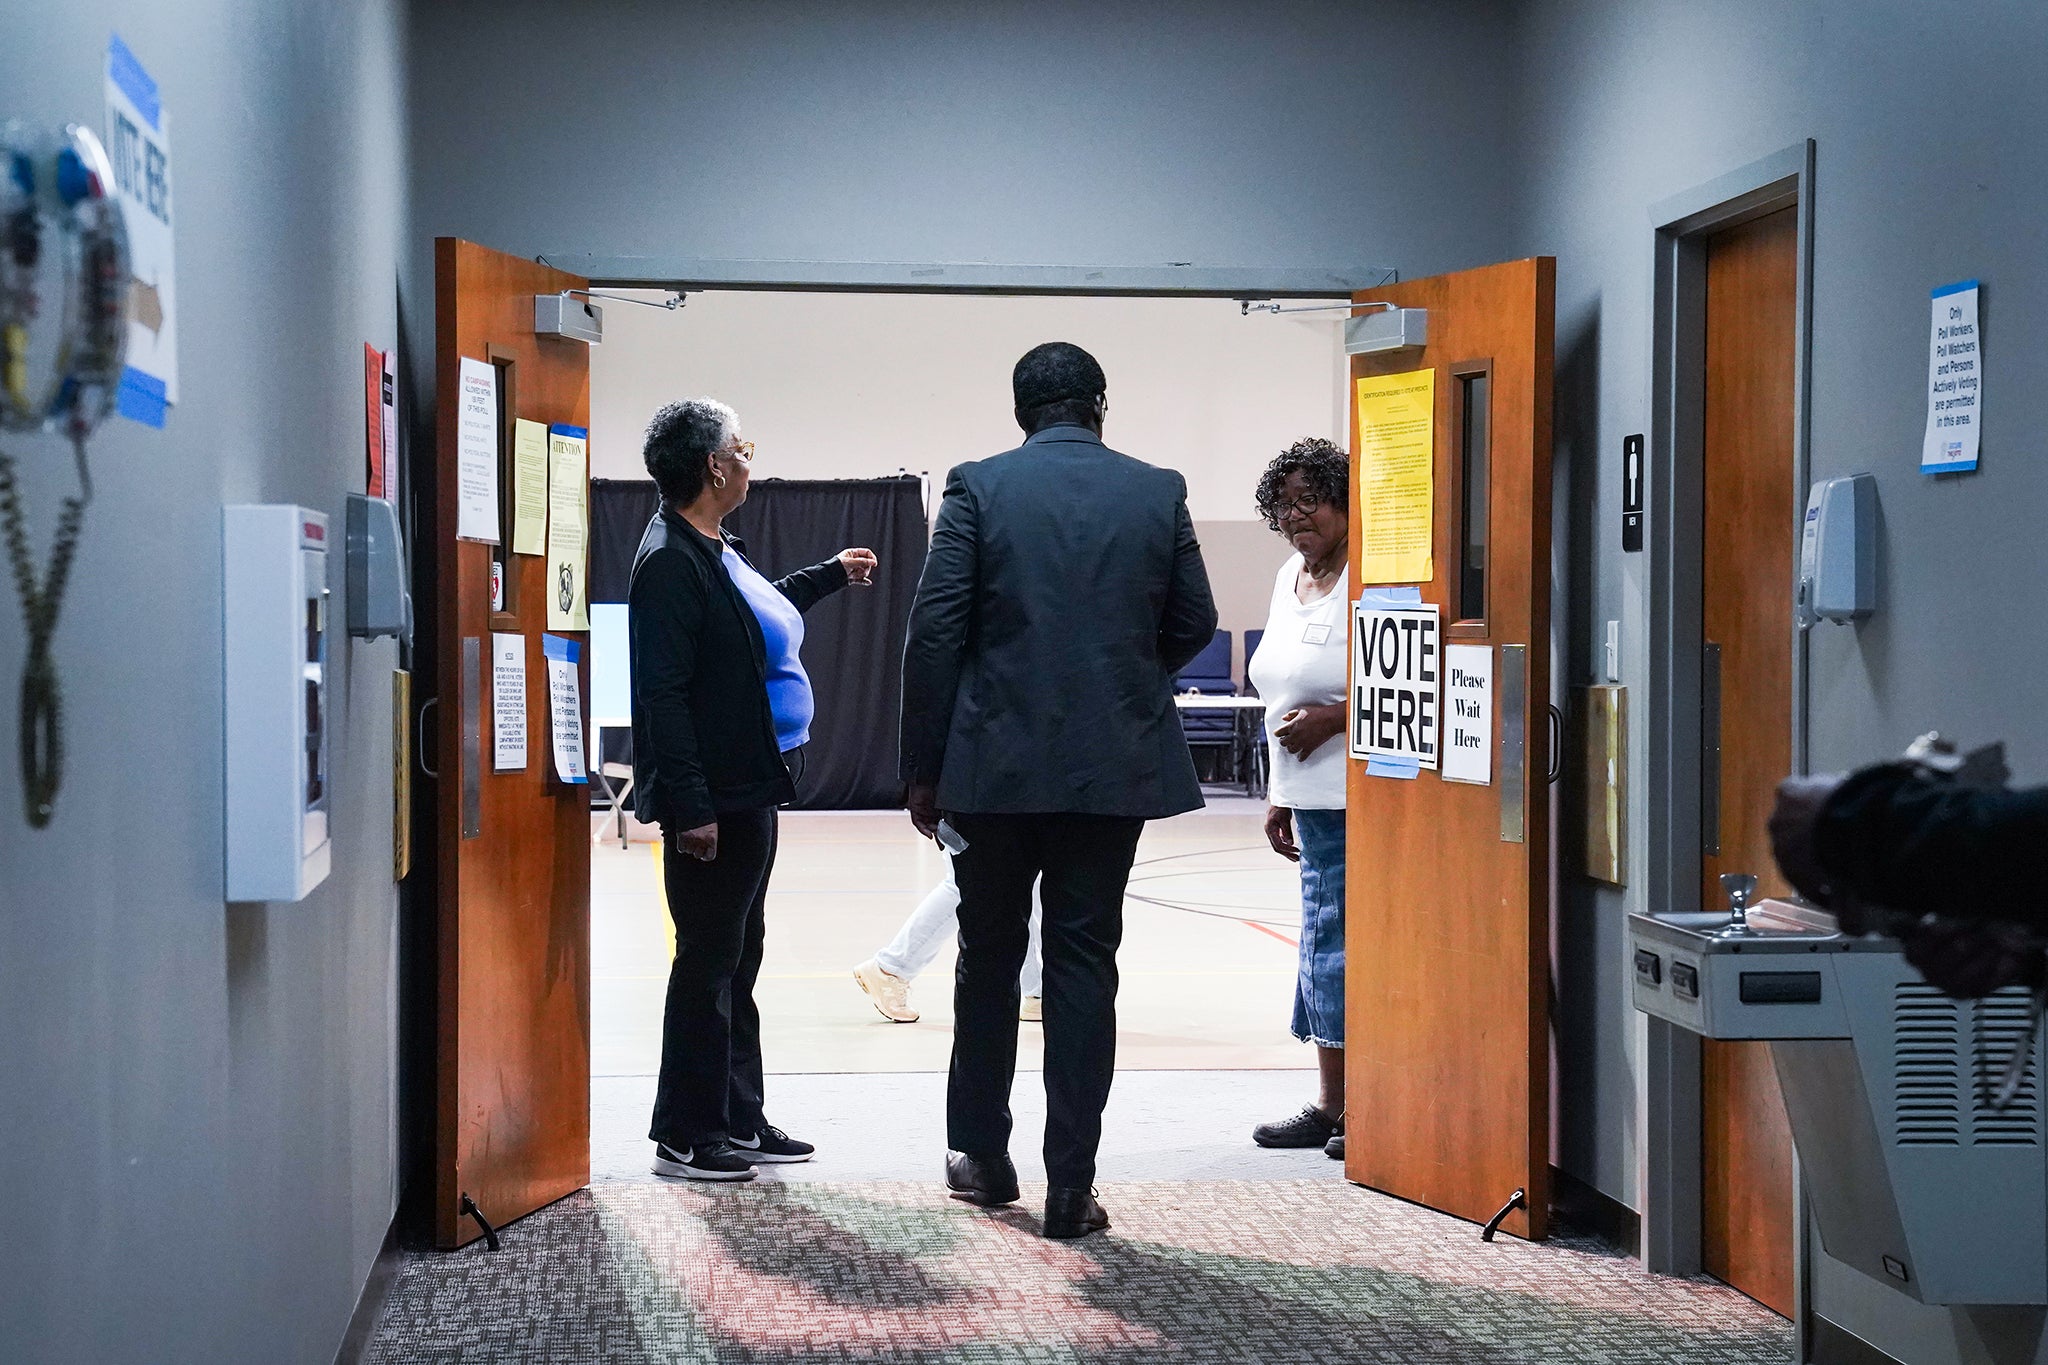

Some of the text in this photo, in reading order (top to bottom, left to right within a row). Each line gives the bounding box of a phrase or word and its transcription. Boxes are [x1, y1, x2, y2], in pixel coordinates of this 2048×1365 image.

[1950, 305, 1963, 322] Only
[1938, 326, 1949, 340] Poll
[1937, 341, 1976, 358] Poll Watchers
[1938, 360, 1974, 376] and Persons
[1933, 375, 1978, 394] Actively Voting
[1935, 394, 1975, 412] are permitted
[1936, 416, 1943, 428] in
[1944, 413, 1955, 427] this
[553, 441, 582, 456] ATTENTION
[1359, 617, 1435, 682] VOTE
[1451, 668, 1485, 689] Please
[1455, 698, 1481, 719] Wait
[1356, 686, 1434, 754] HERE
[1454, 728, 1481, 749] Here
